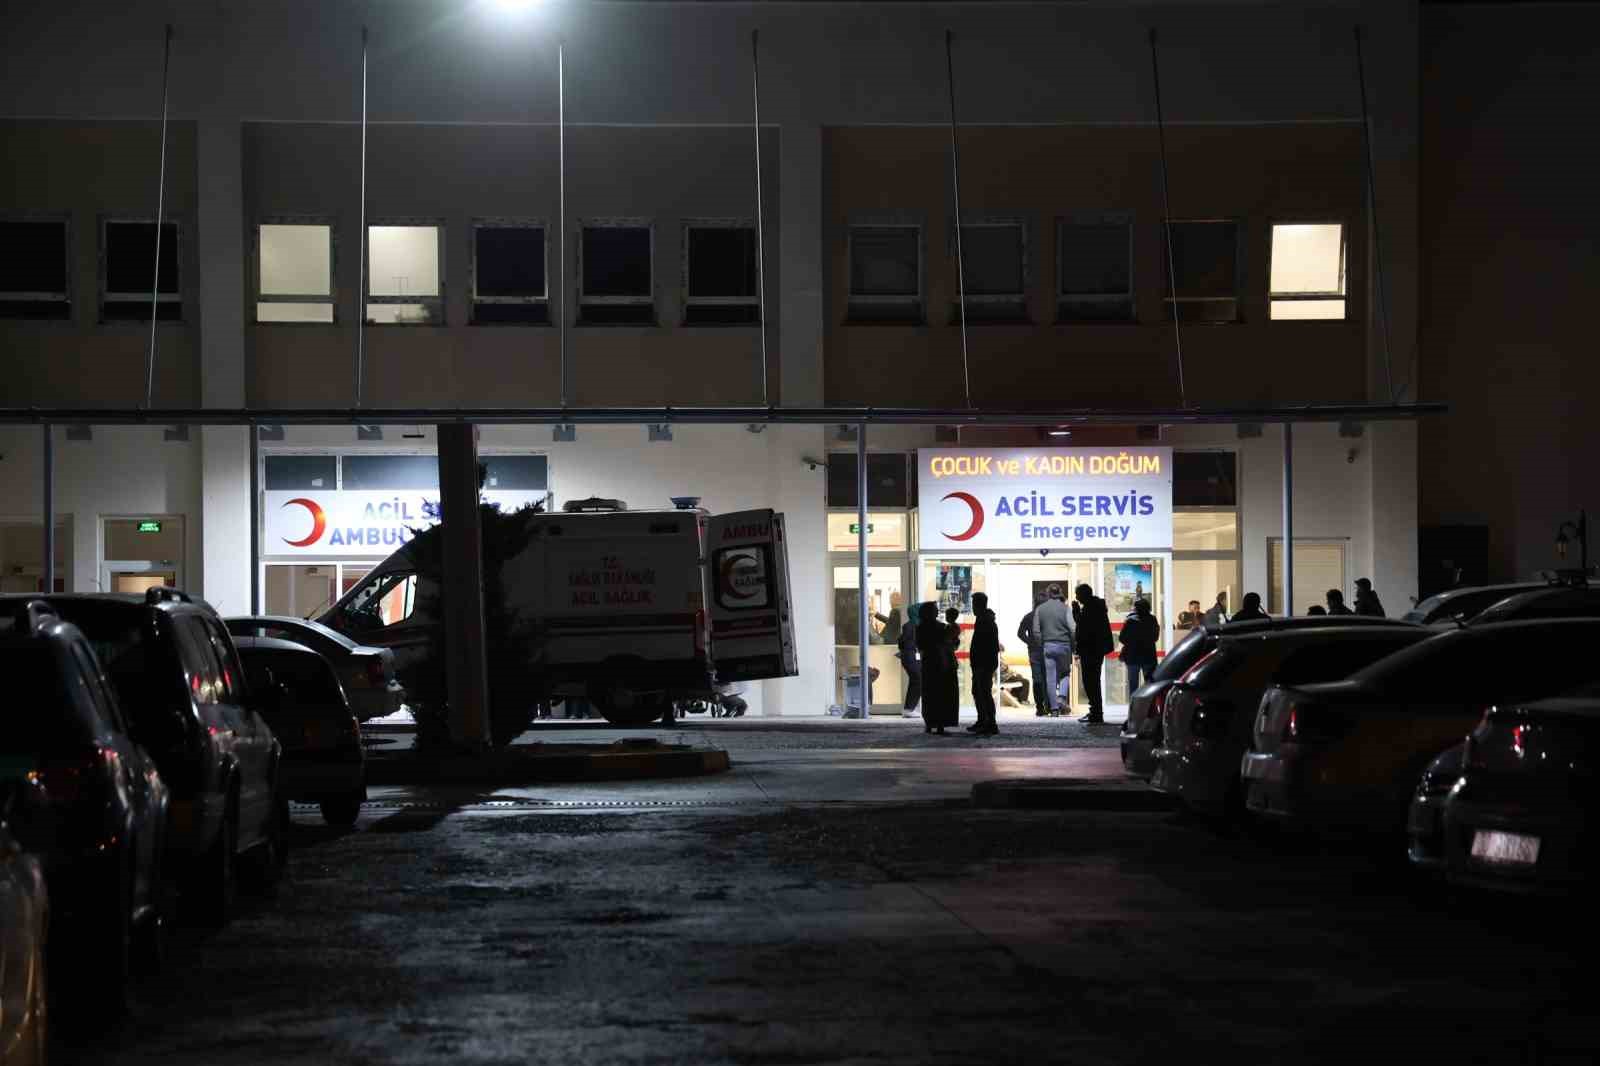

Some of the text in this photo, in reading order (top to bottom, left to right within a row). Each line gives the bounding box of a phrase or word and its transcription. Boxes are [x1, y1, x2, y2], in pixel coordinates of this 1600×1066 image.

[931, 451, 1160, 477] ÇOCUK ve KADIN DOĞUM
[363, 497, 414, 519] ACİL
[994, 489, 1154, 516] ACİL SERVİS
[1020, 523, 1130, 541] Emergency
